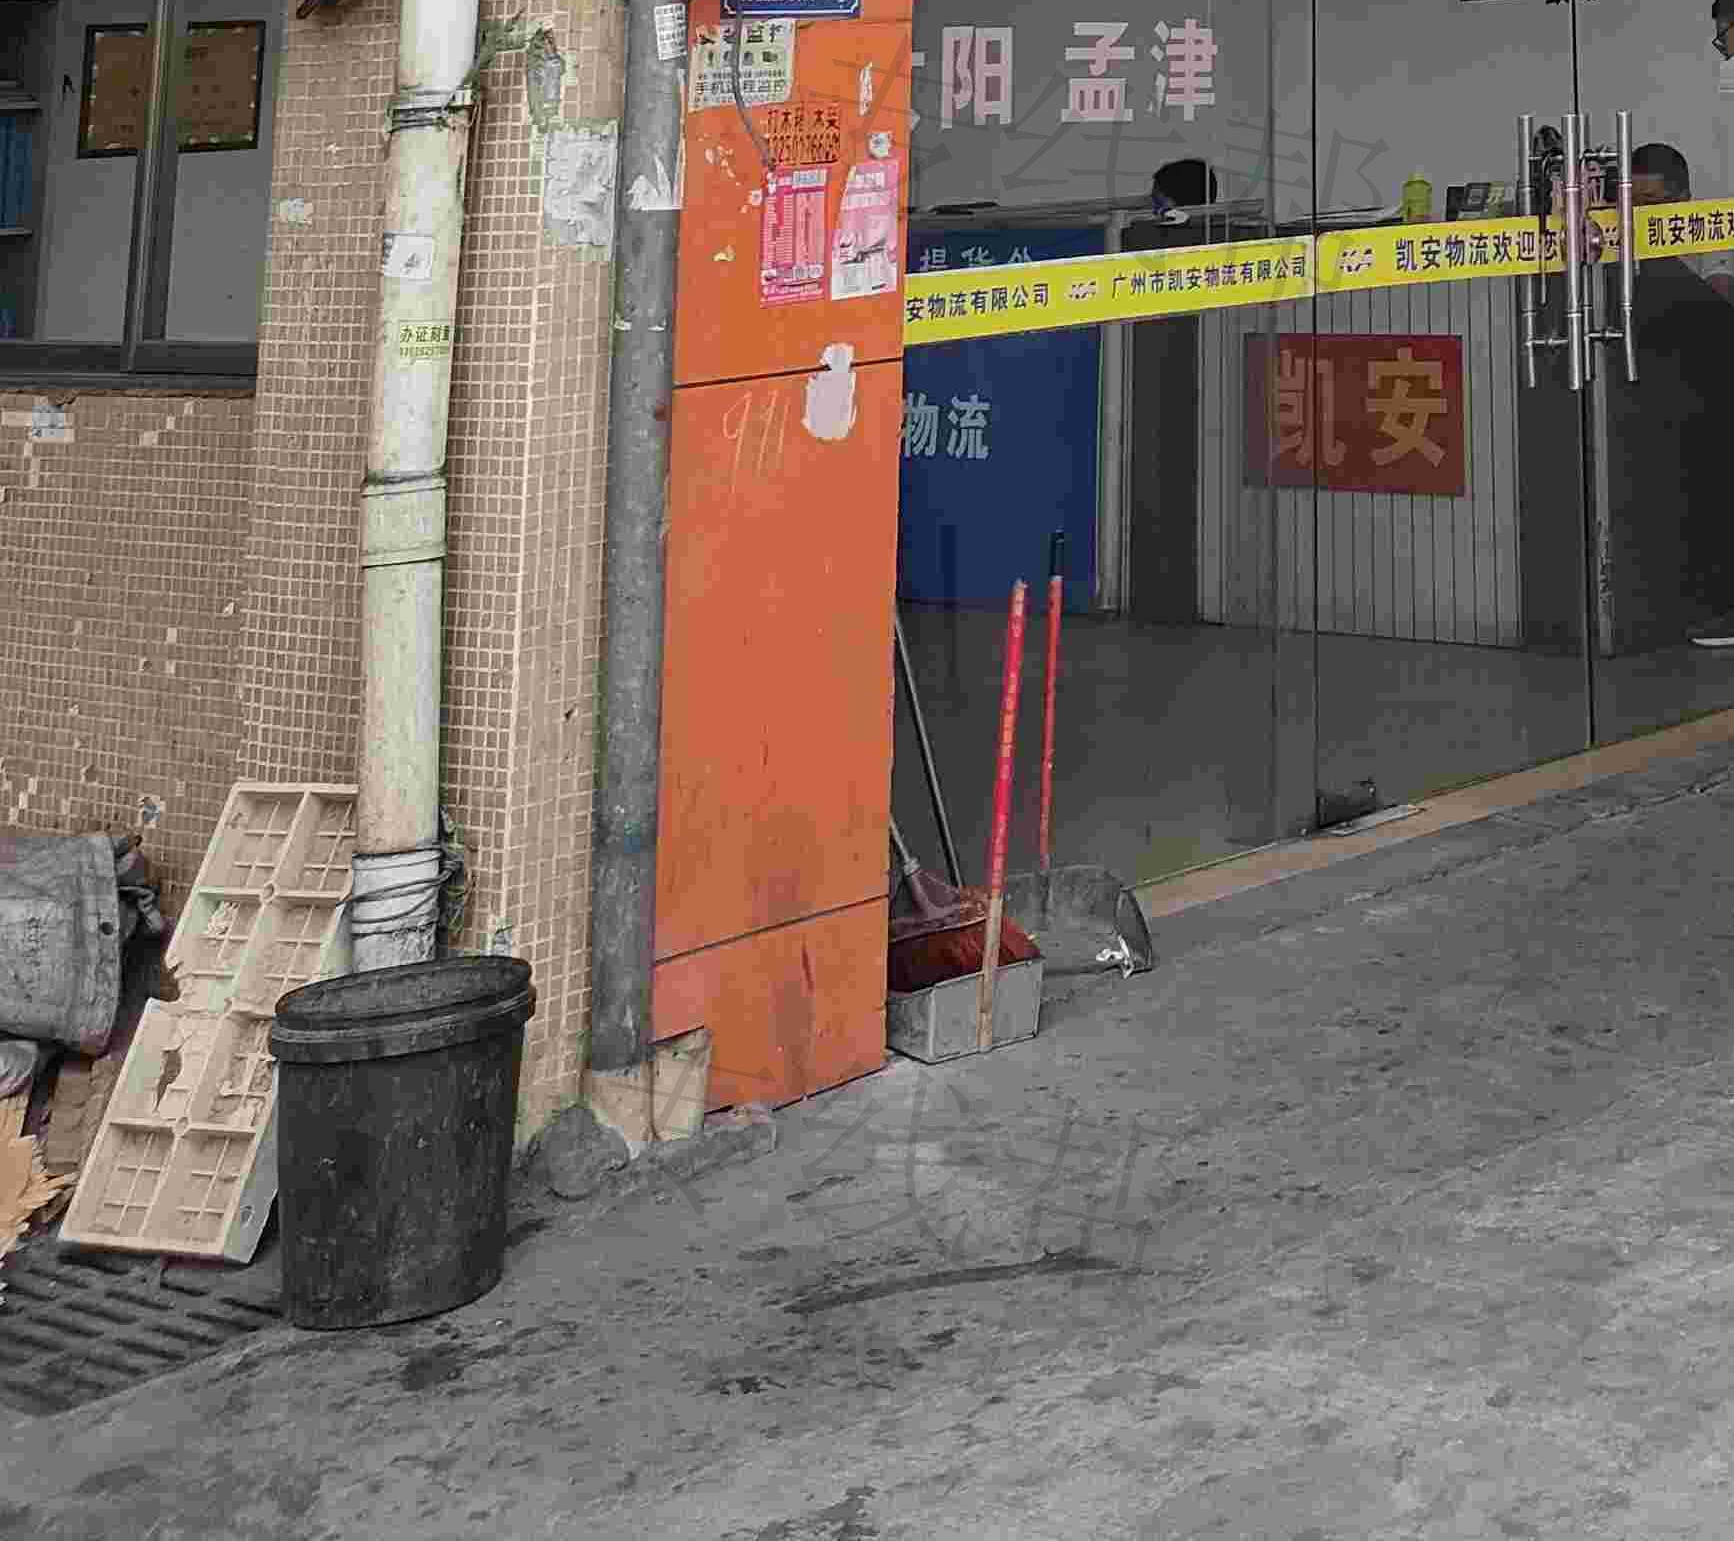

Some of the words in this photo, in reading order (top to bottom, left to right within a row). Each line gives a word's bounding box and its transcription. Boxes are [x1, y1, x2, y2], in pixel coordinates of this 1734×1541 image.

[911, 24, 1014, 129] 阳
[1060, 18, 1219, 124] 孟津
[906, 282, 1050, 323] 安物流有限公司
[1111, 255, 1307, 299] 广州市凯安物流有限公司
[901, 392, 992, 460] 物流
[1270, 348, 1448, 468] 凯安
